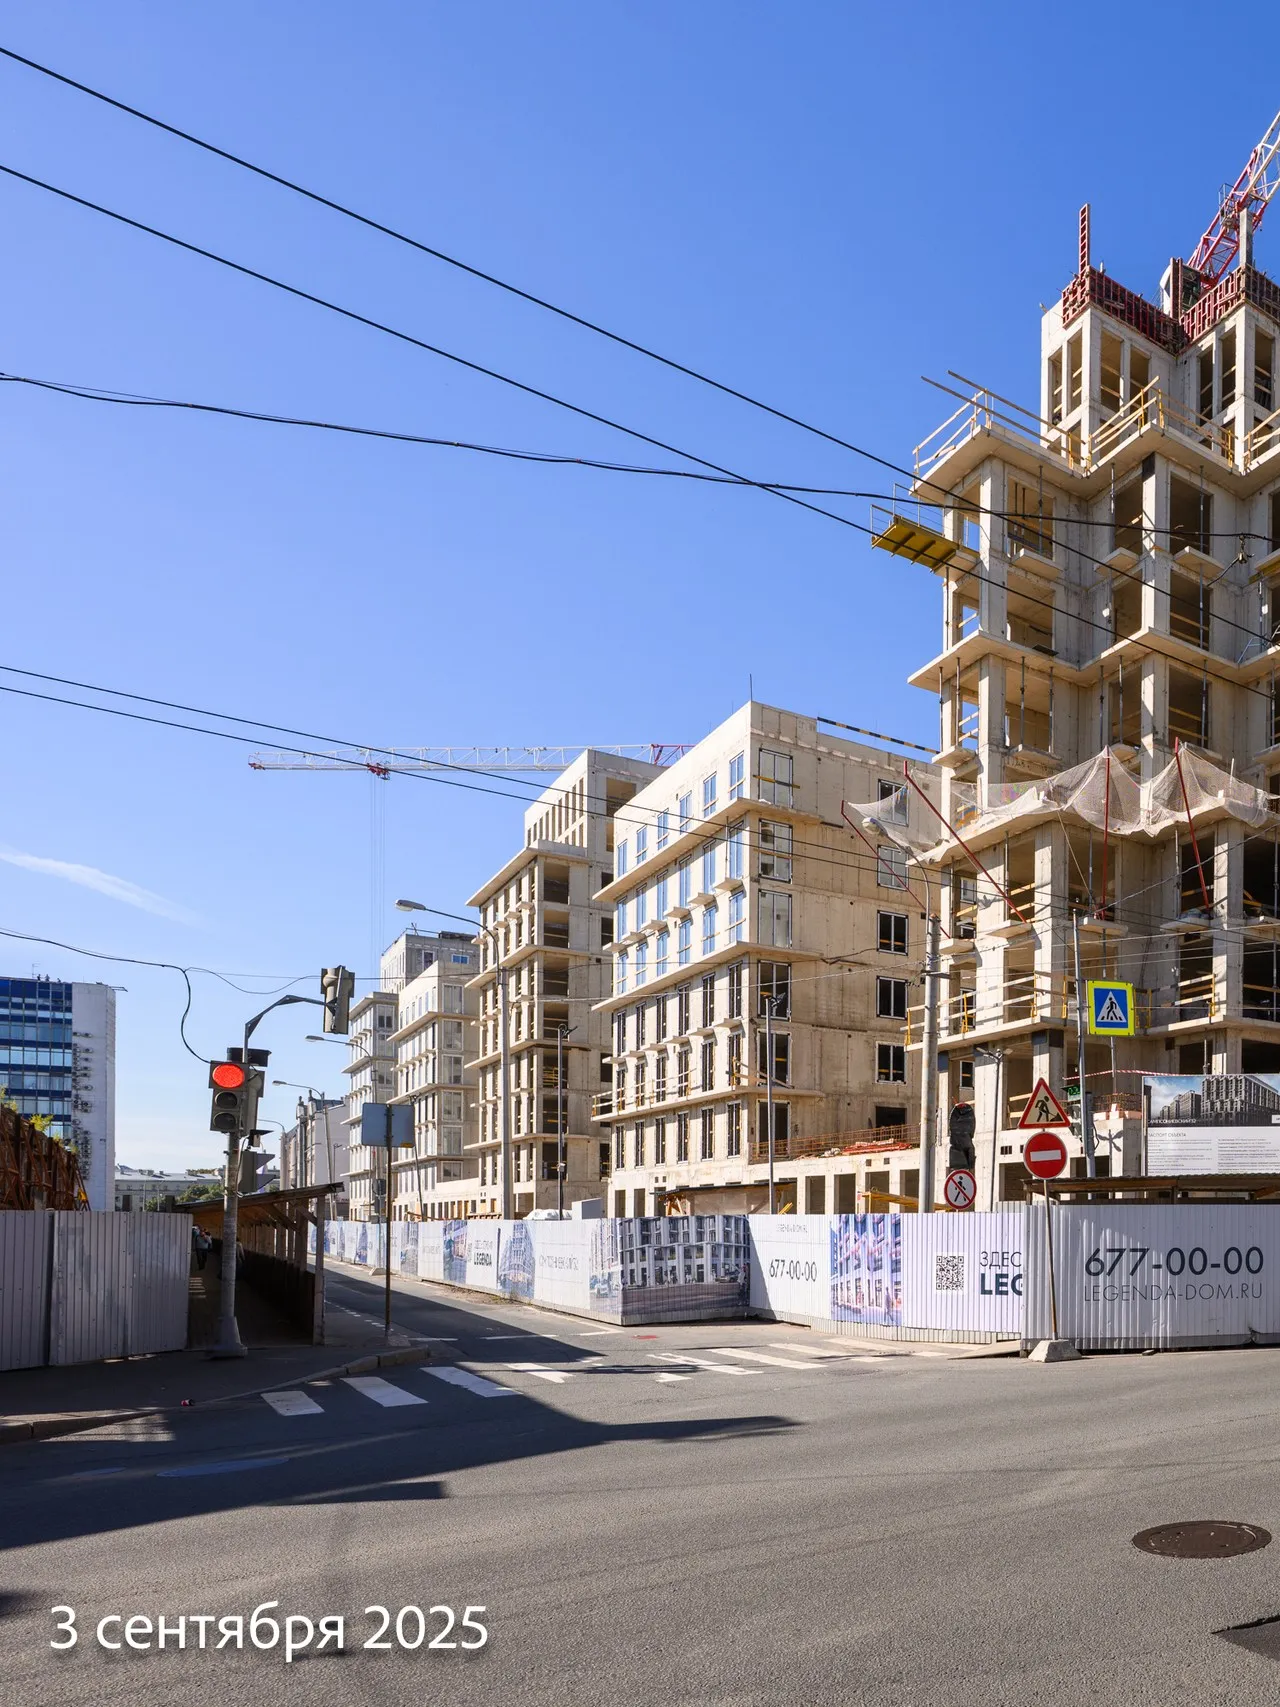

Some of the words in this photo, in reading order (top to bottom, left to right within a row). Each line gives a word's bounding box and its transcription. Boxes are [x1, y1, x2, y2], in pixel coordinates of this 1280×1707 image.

[979, 1251, 1022, 1269] ЗДЕС
[1084, 1246, 1264, 1276] 677-00-00
[1084, 1282, 1263, 1301] LEGENDA-DOM.RU
